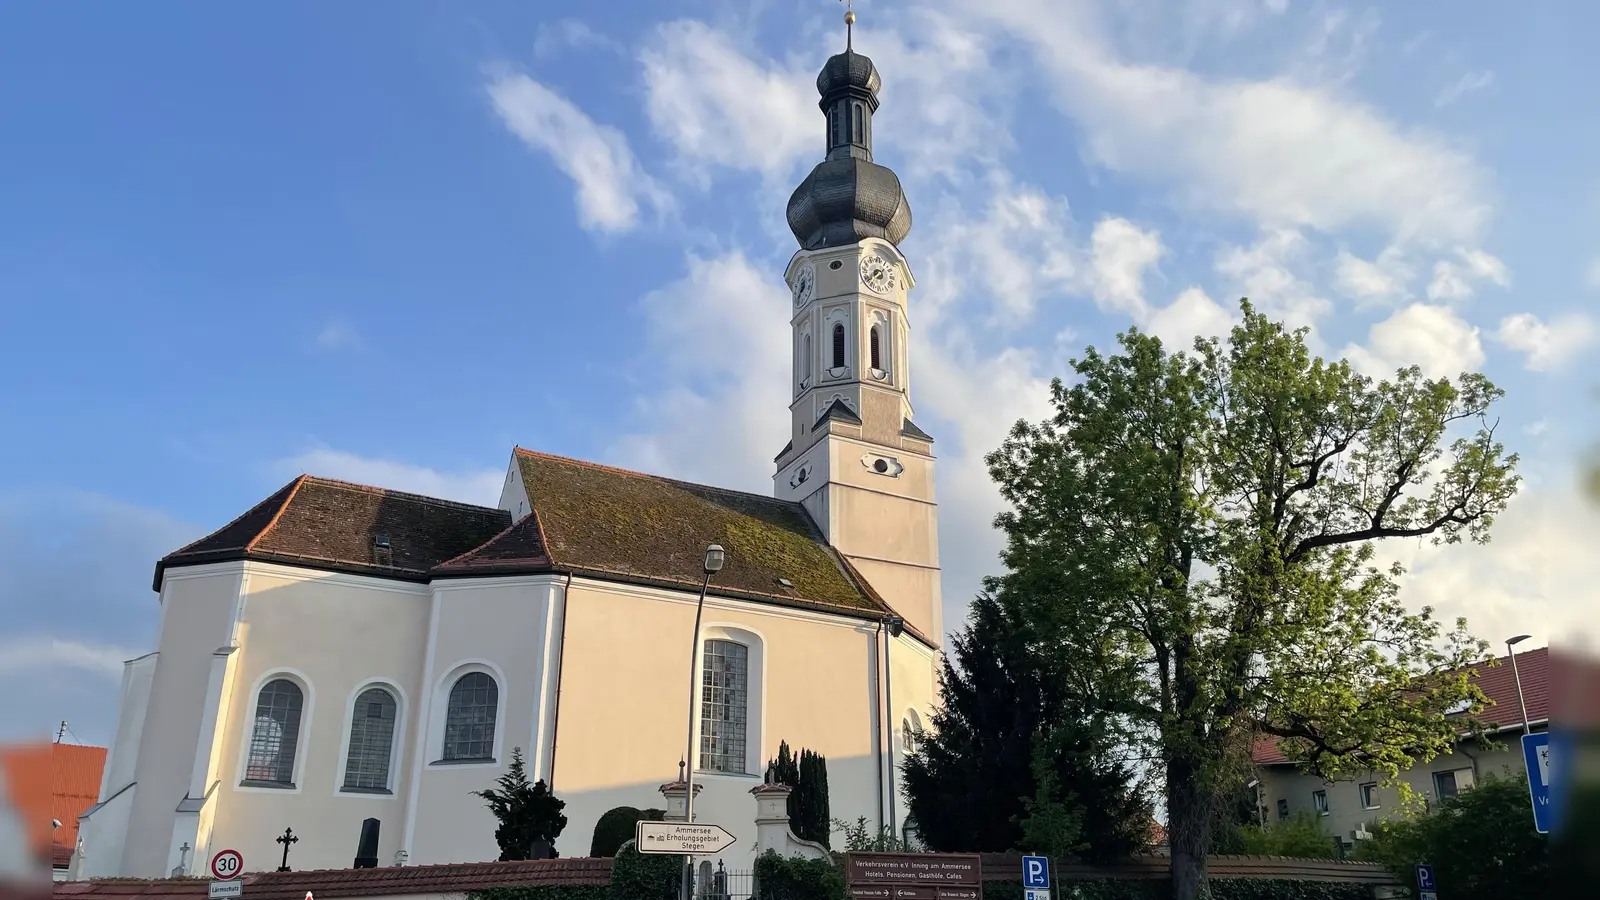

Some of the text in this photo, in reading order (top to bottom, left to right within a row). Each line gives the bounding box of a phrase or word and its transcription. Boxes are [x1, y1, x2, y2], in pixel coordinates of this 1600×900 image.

[666, 834, 719, 842] Erholungsgebiet
[218, 857, 237, 871] 30
[855, 860, 898, 868] Verkehrsverein
[1029, 860, 1042, 883] P
[1419, 868, 1428, 887] P
